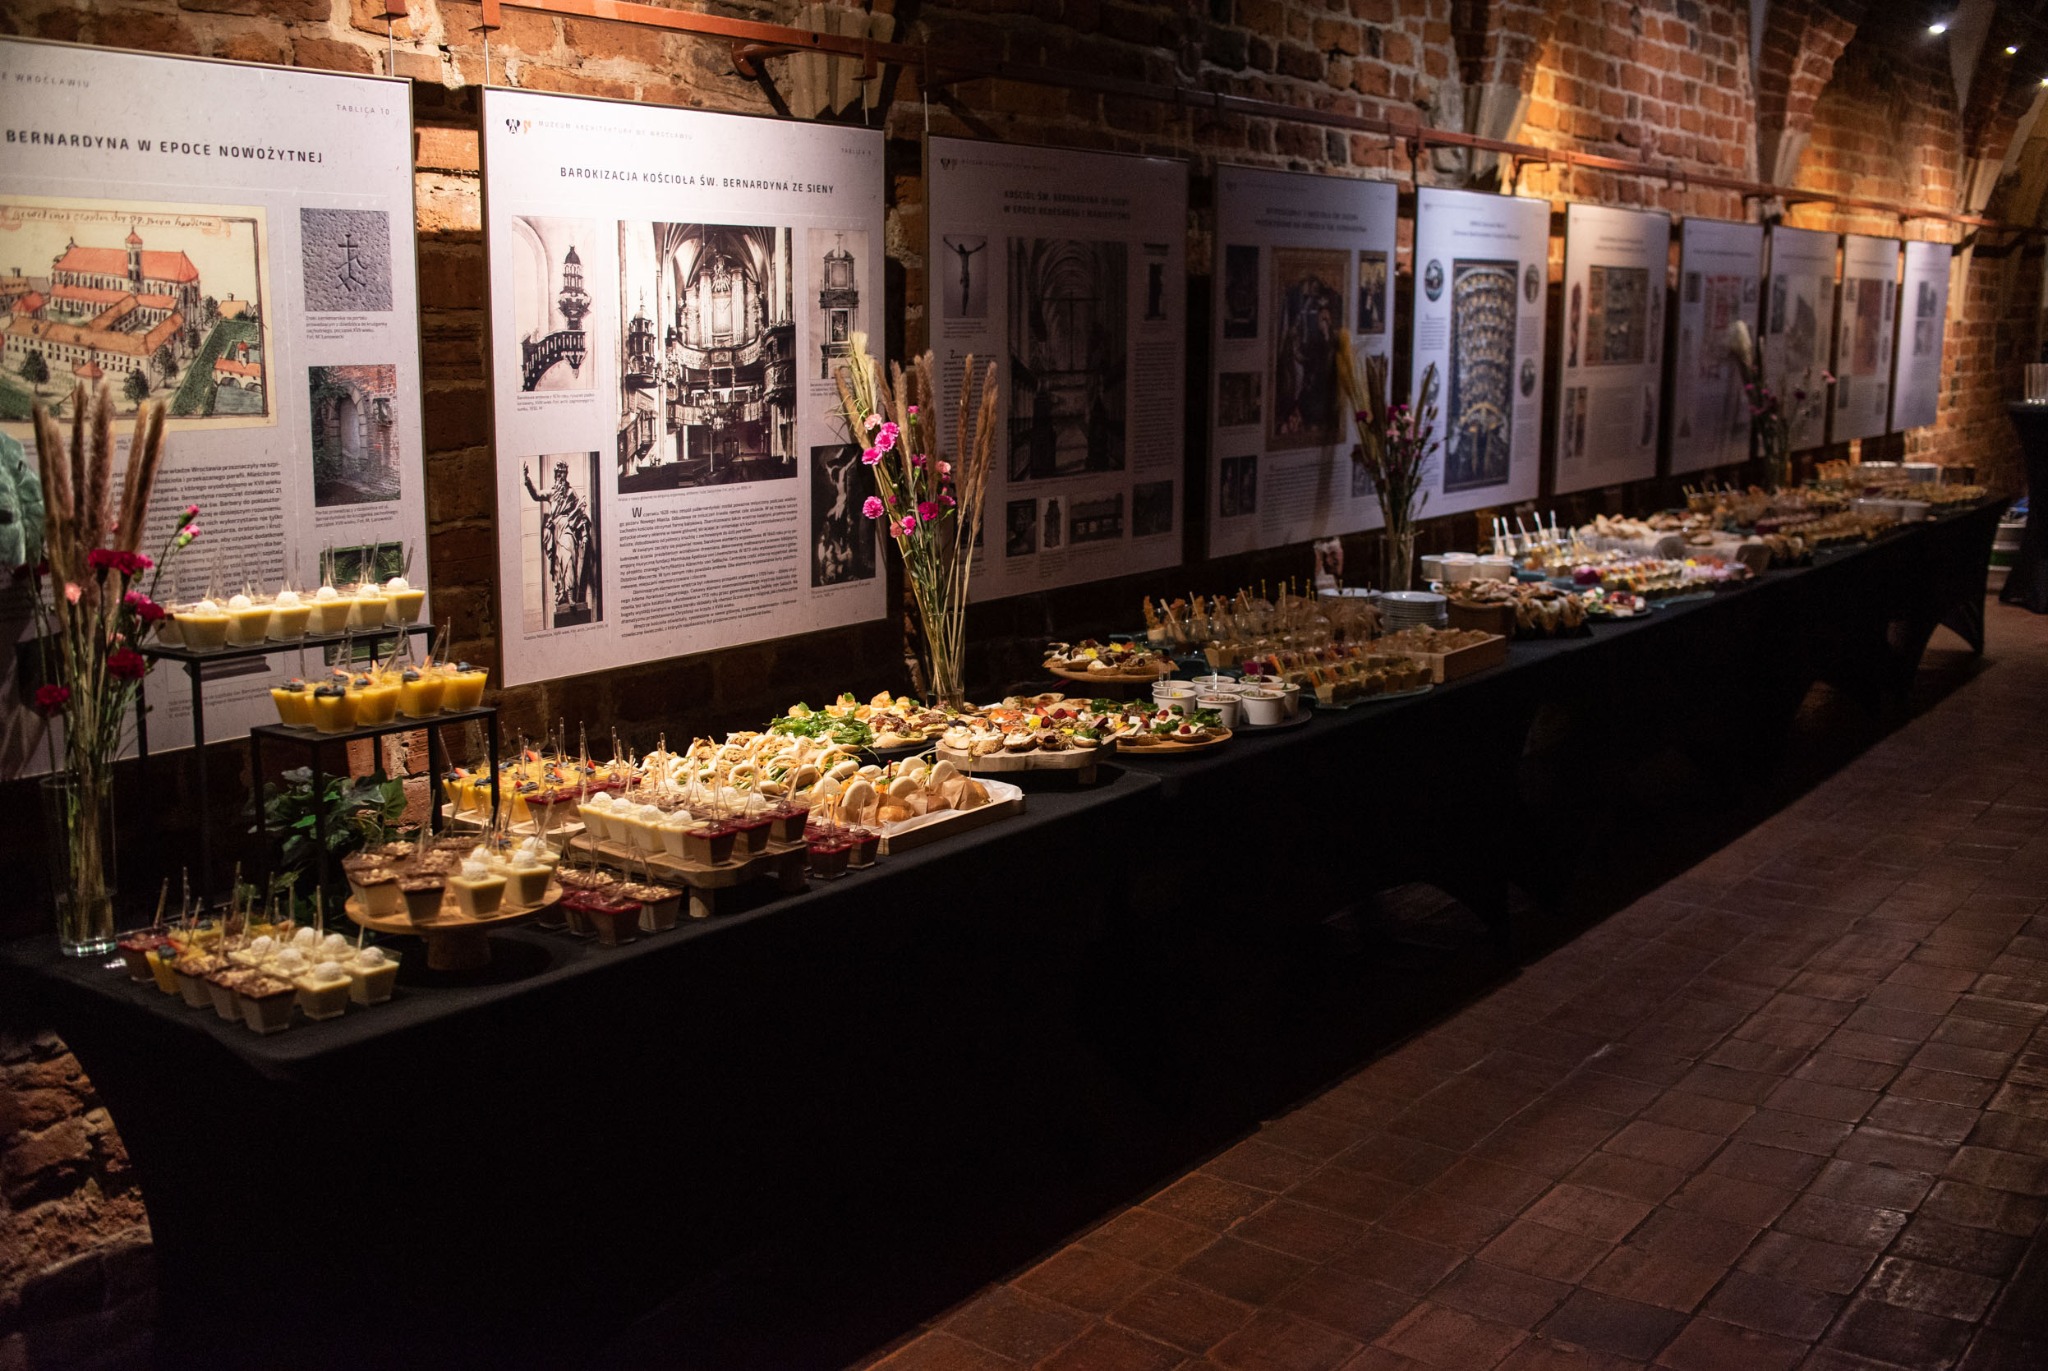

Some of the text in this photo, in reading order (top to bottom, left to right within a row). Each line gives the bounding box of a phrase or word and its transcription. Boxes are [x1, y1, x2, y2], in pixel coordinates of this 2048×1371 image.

[336, 104, 391, 116] TABLICA 10
[6, 129, 322, 163] BERNARDYNA W EPOCE NOWOŻYTNEJ
[560, 166, 833, 194] BAROKIZACJA KOŚCIOŁA ŚW. BERNARDYNA ZE SIENY
[632, 506, 642, 518] W
